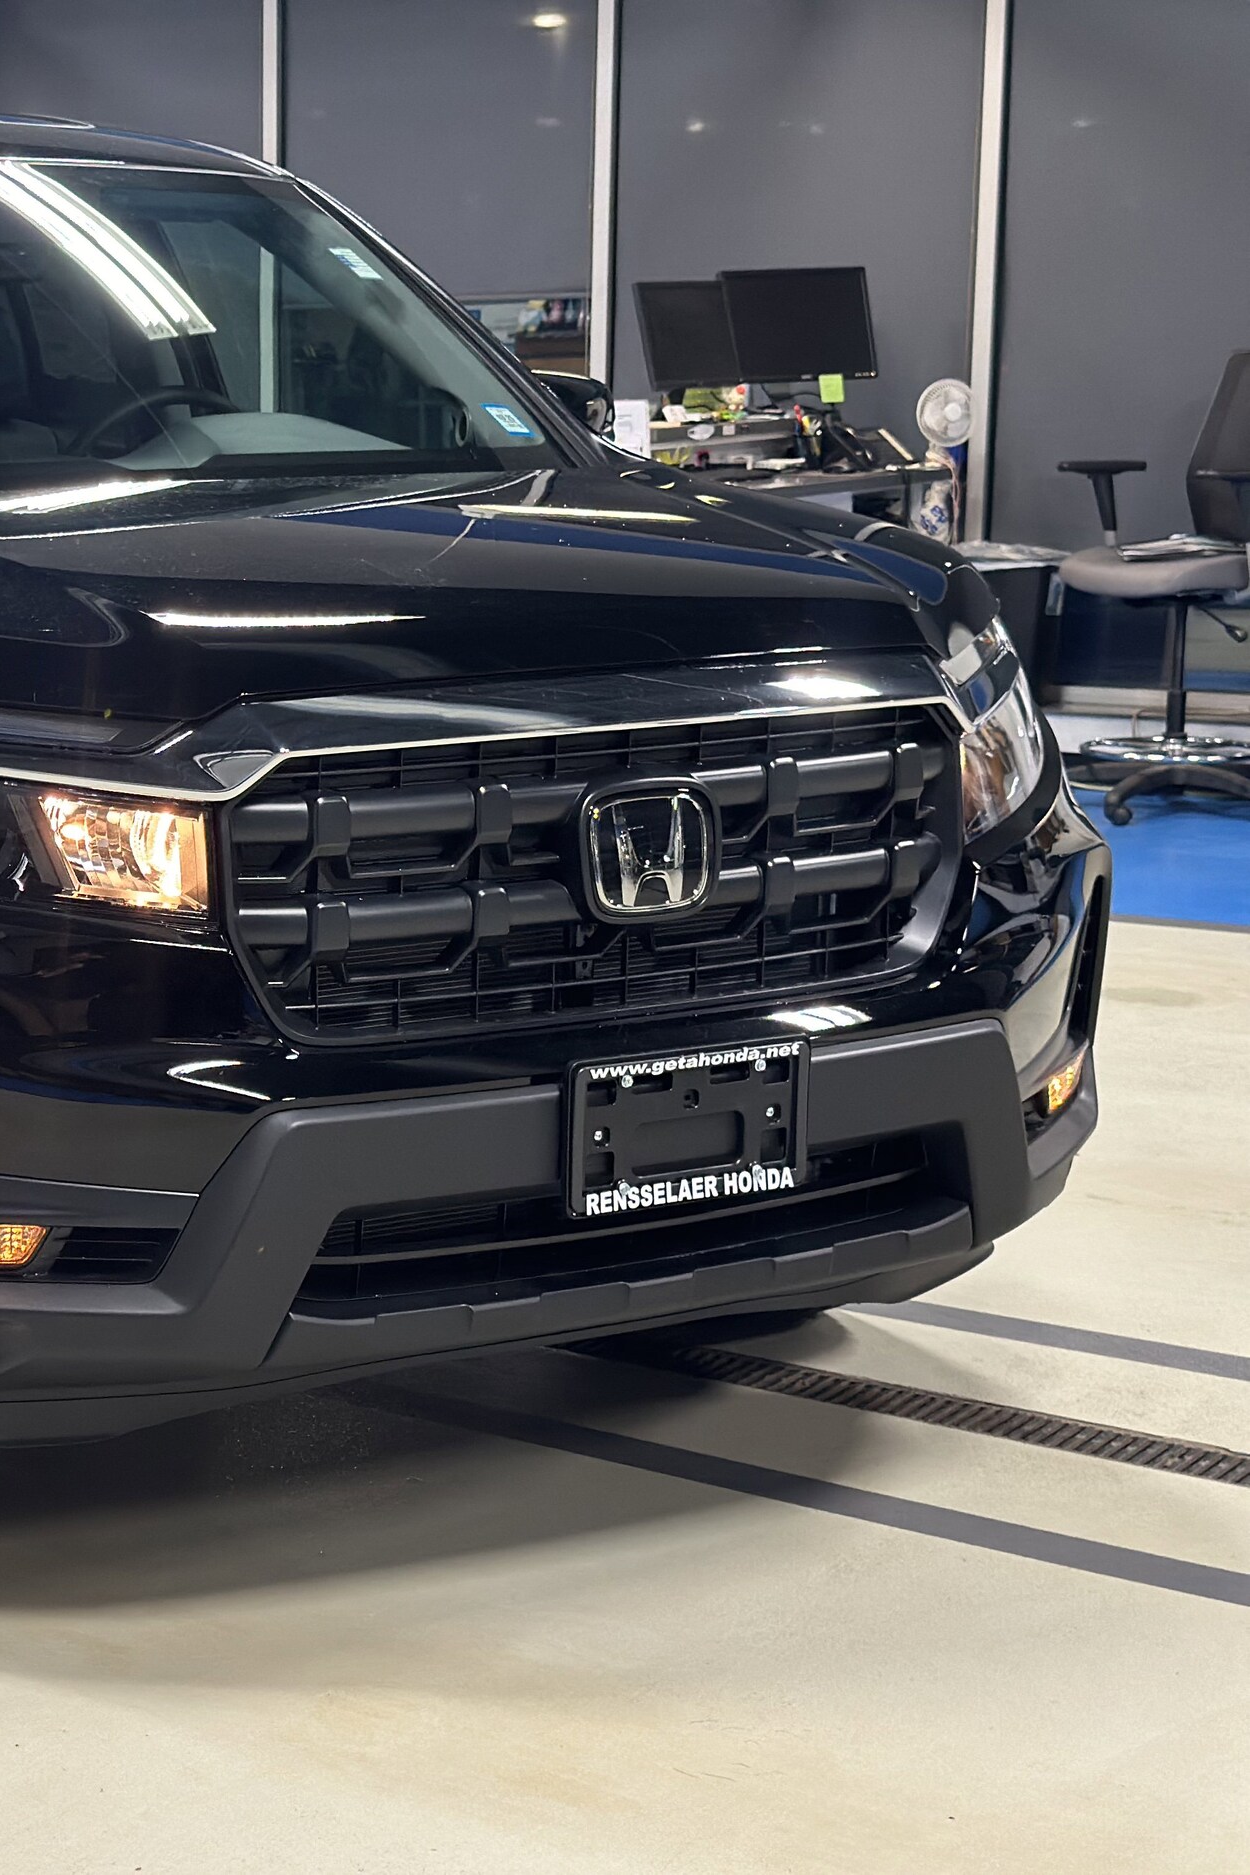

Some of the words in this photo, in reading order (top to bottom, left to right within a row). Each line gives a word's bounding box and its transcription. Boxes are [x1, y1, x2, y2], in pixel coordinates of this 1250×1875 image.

[590, 1042, 800, 1080] www.getahonda.net
[586, 1175, 719, 1216] RENSSELAER
[723, 1166, 795, 1196] HONDA
